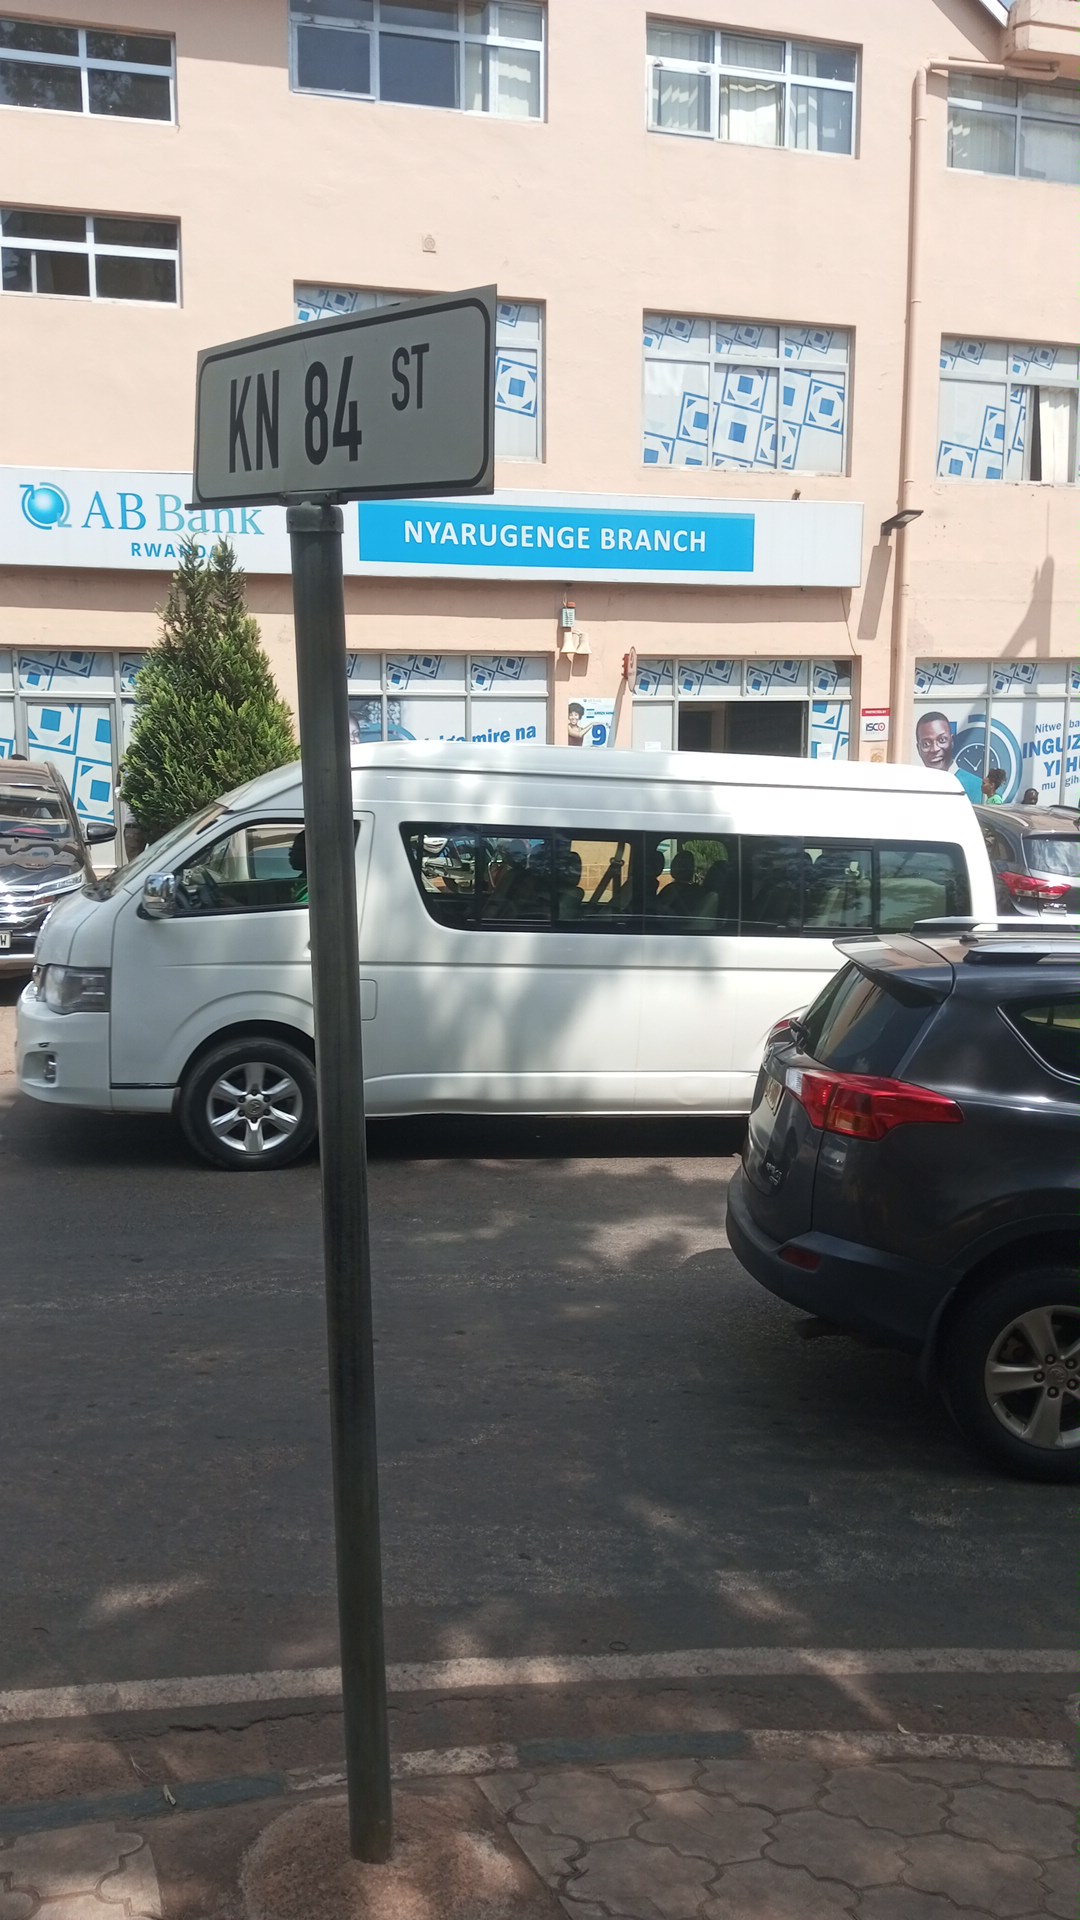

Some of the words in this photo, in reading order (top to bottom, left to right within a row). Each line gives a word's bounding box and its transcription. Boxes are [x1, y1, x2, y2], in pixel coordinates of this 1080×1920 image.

[229, 370, 279, 473] KN
[304, 356, 362, 465] 84
[392, 343, 429, 411] ST
[81, 491, 146, 530] AB
[156, 493, 264, 535] Bank
[404, 520, 590, 549] NYARUGENGE
[600, 527, 706, 552] BRANCH
[516, 725, 536, 741] na
[1035, 722, 1062, 734] Nitwe
[1042, 781, 1056, 790] mu
